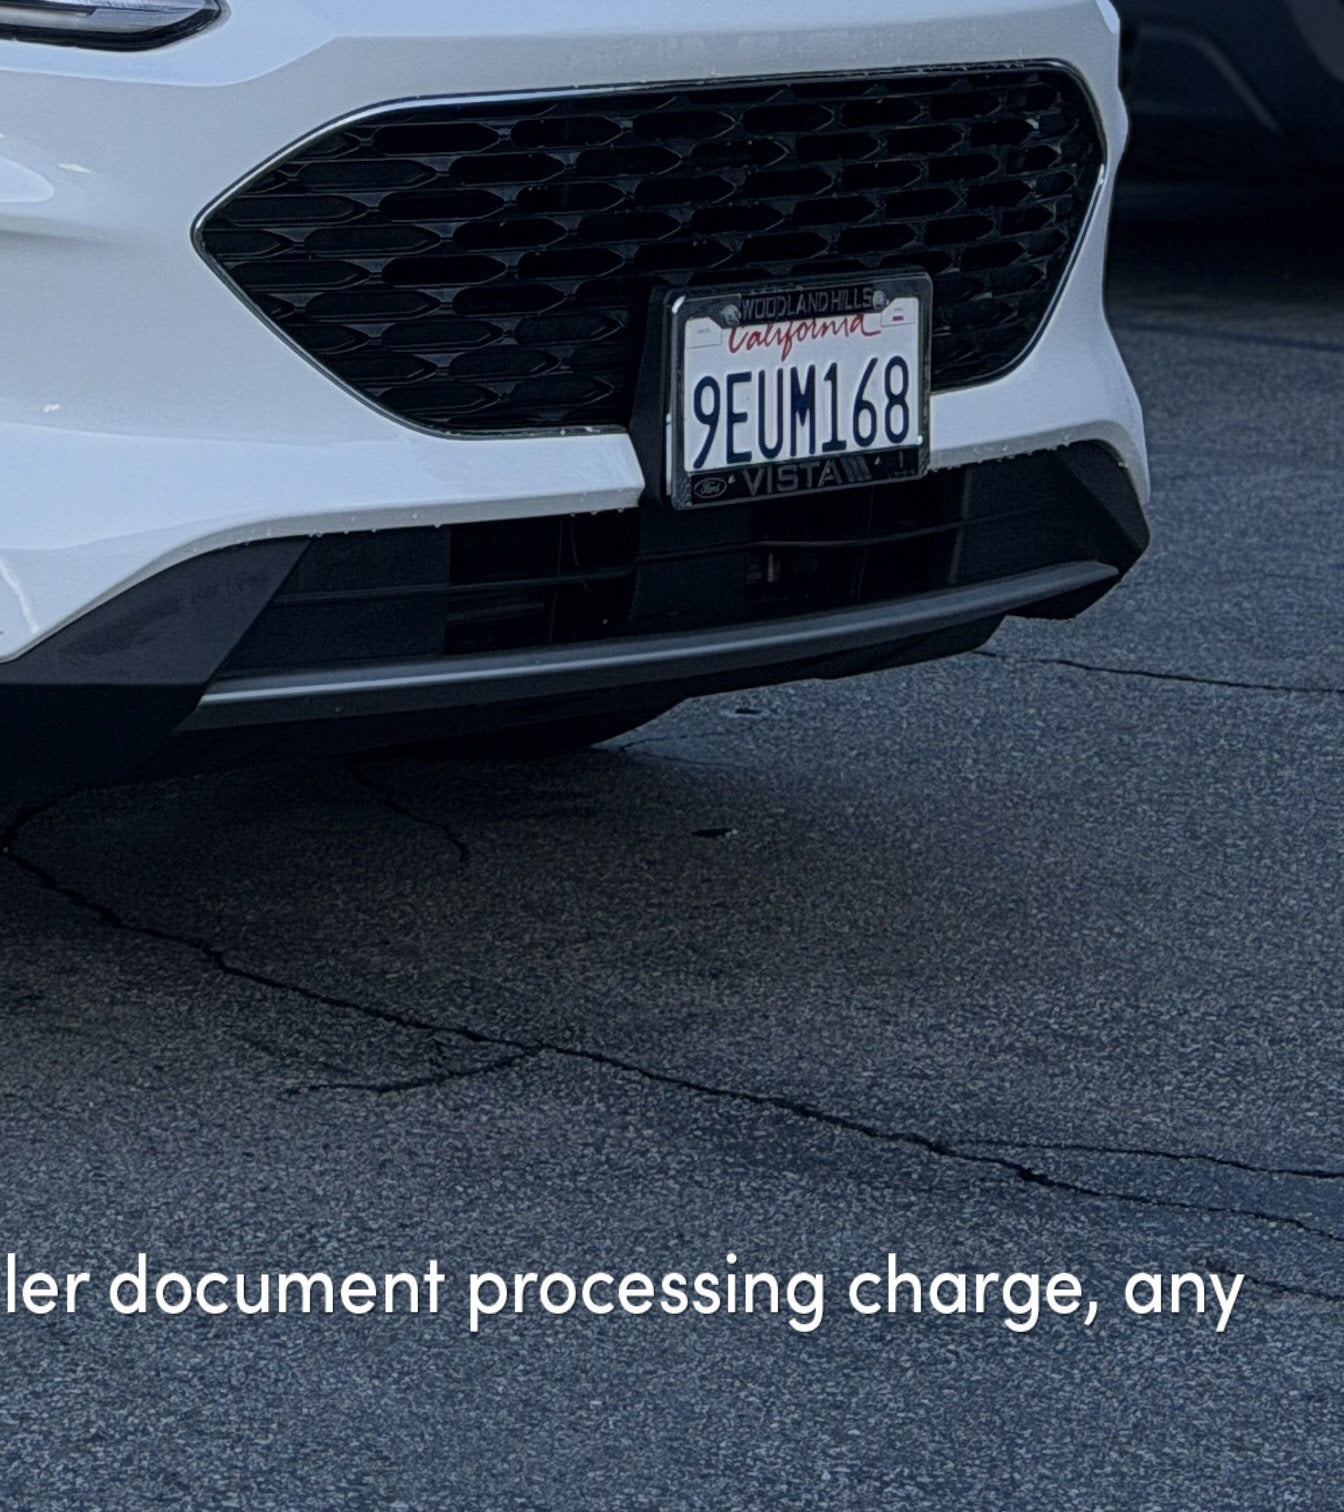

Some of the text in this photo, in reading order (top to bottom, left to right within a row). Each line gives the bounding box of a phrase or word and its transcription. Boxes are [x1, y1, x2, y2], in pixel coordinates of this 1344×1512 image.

[741, 286, 875, 320] WOODLAND HILLS
[727, 312, 882, 362] California
[693, 355, 910, 470] 9EUM168
[741, 458, 846, 497] VISTA
